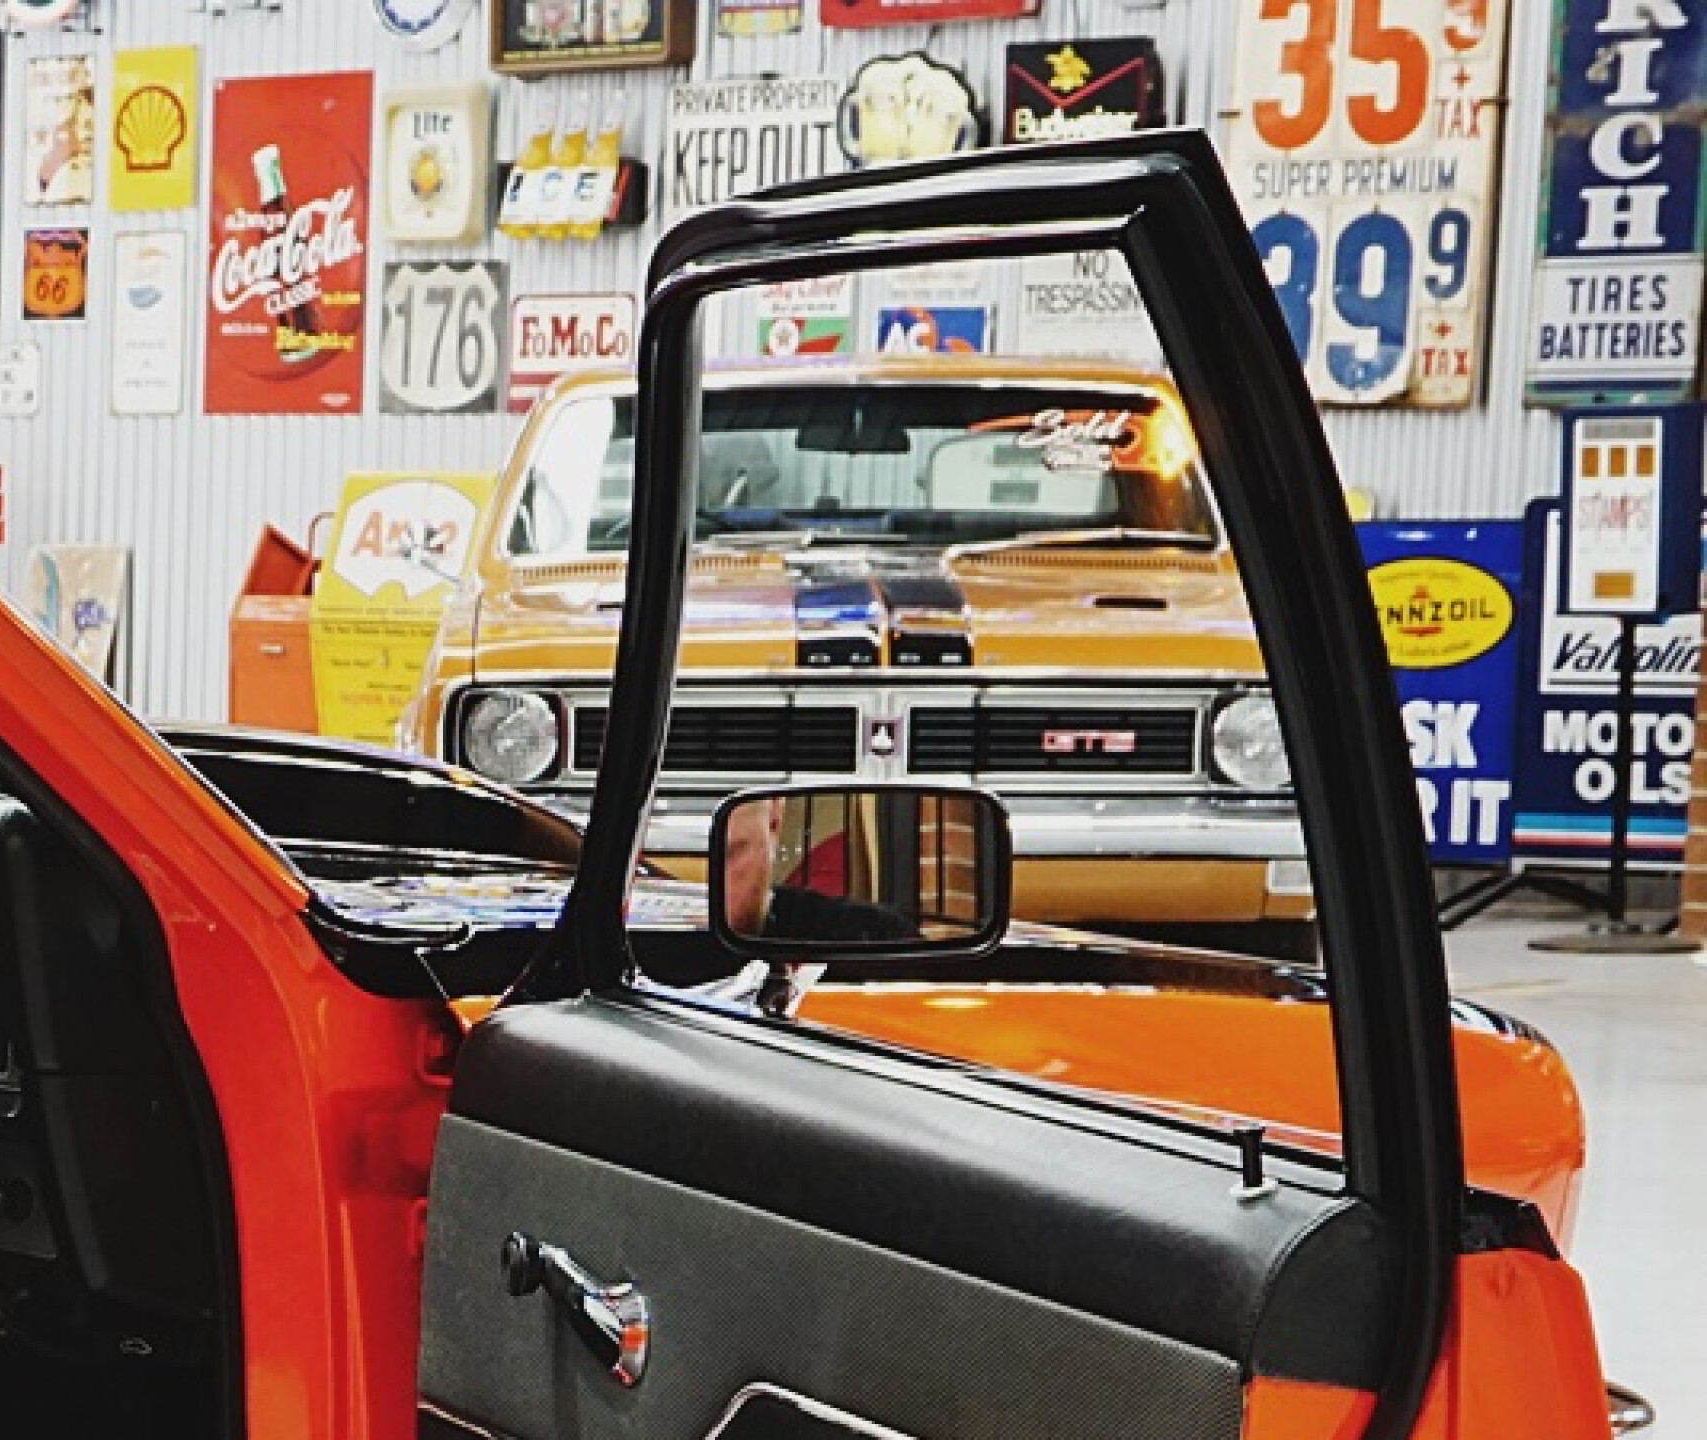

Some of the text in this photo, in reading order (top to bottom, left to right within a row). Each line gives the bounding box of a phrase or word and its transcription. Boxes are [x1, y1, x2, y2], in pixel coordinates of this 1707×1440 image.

[1253, 0, 1431, 150] 35
[673, 121, 835, 208] KEEP OUT
[1254, 156, 1458, 199] SUPER PREMIUM
[1073, 250, 1110, 279] NO
[35, 272, 70, 304] 66
[1567, 274, 1668, 314] TIRES
[394, 284, 487, 390] 176
[518, 313, 629, 359] FoMoCo
[1539, 320, 1687, 360] BATTERIES
[1377, 599, 1496, 625] NNZOIL
[1400, 698, 1480, 771] SK
[1544, 711, 1694, 756] MOTO
[1574, 758, 1692, 804] OLS
[1448, 778, 1512, 845] IT
